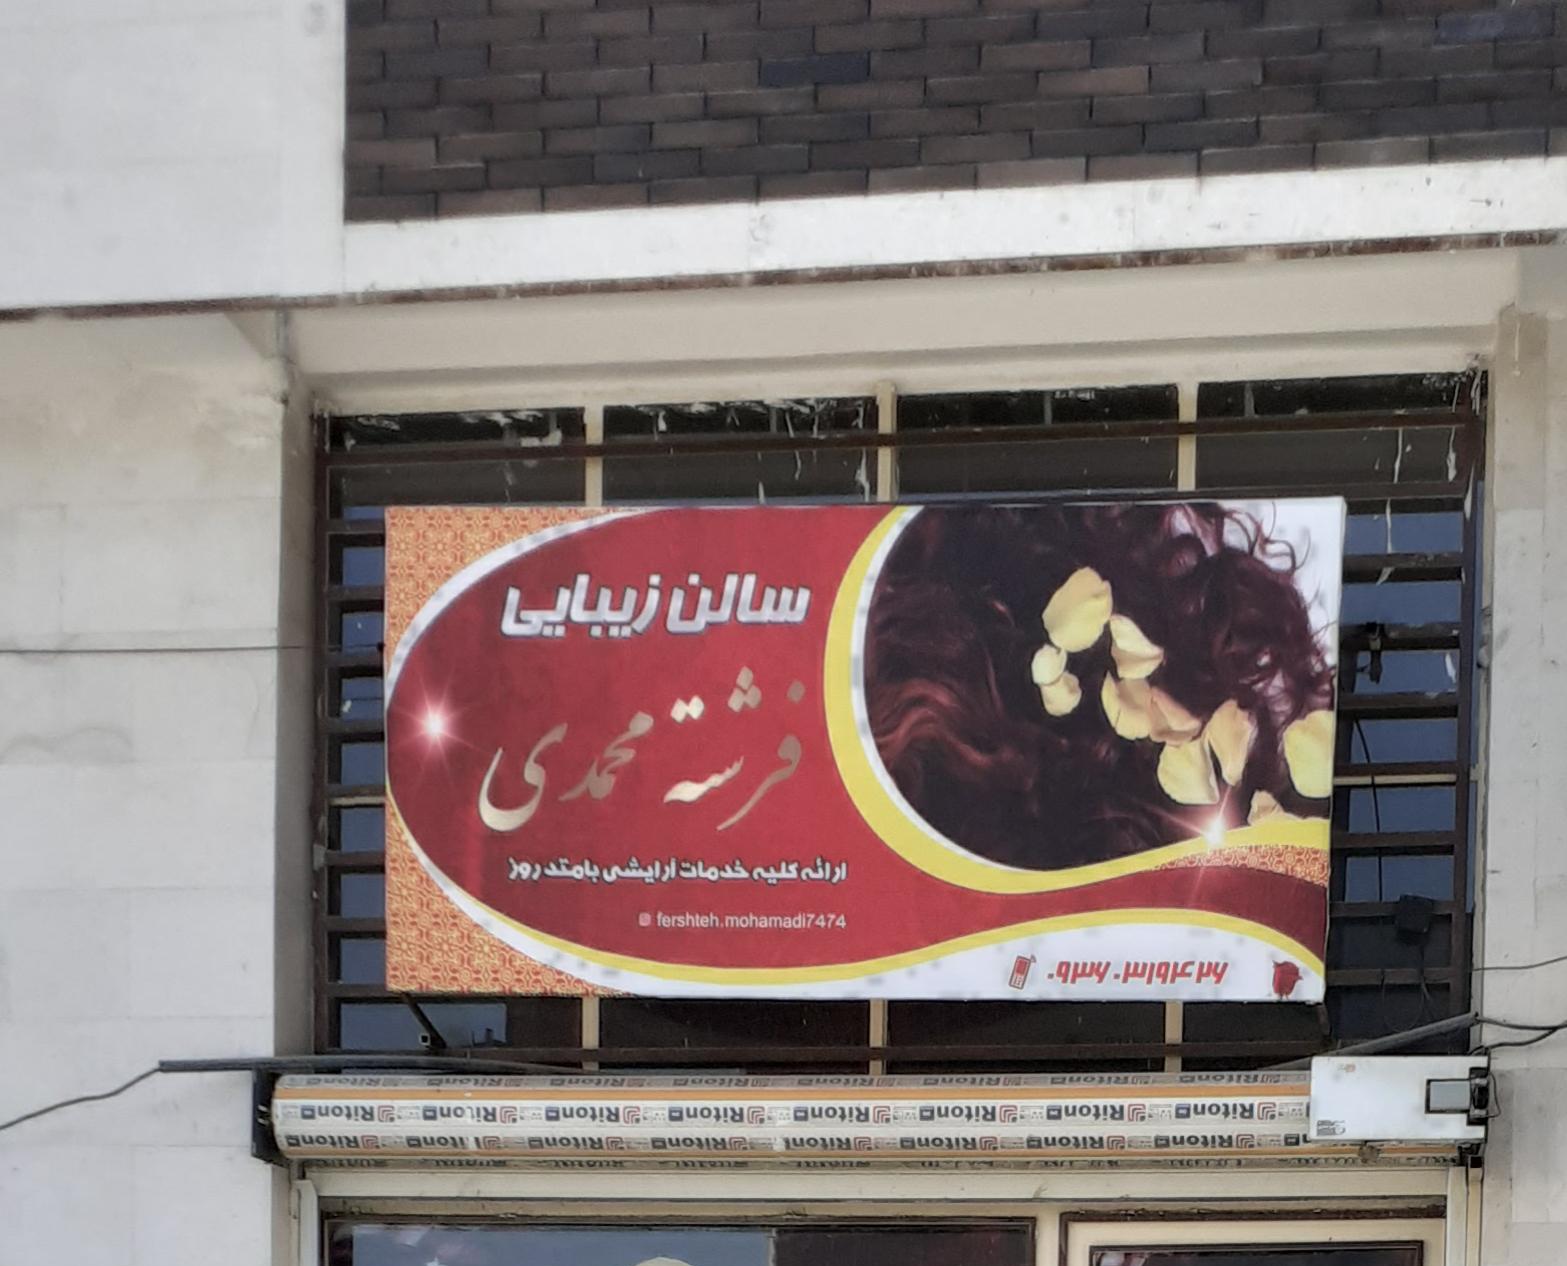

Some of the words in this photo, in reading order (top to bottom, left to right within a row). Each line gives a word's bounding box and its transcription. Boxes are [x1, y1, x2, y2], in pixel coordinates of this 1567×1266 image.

[500, 572, 662, 638] زیبایی
[665, 572, 811, 635] سالن
[664, 666, 805, 832] فرشته
[478, 711, 653, 832] محمدی
[508, 856, 542, 881] روز
[679, 858, 750, 882] خدمات
[751, 860, 799, 885] کلیه
[800, 856, 847, 884] ارائه
[656, 912, 847, 930] fershteh.mohamadi7474
[317, 1105, 375, 1122] Riton
[562, 1106, 621, 1123] Riton
[686, 1106, 744, 1123] Riton
[810, 1106, 870, 1123] Riton
[936, 1105, 996, 1123] Riton
[1064, 1104, 1125, 1121] Riton
[1192, 1103, 1255, 1120] Riton
[302, 1135, 359, 1149] Riton
[544, 1136, 604, 1150] Riton
[668, 1136, 727, 1150] Riton
[792, 1136, 851, 1150] Riton
[917, 1136, 977, 1150] Riton
[1044, 1136, 1104, 1149] Riton
[1172, 1134, 1233, 1149] Riton
